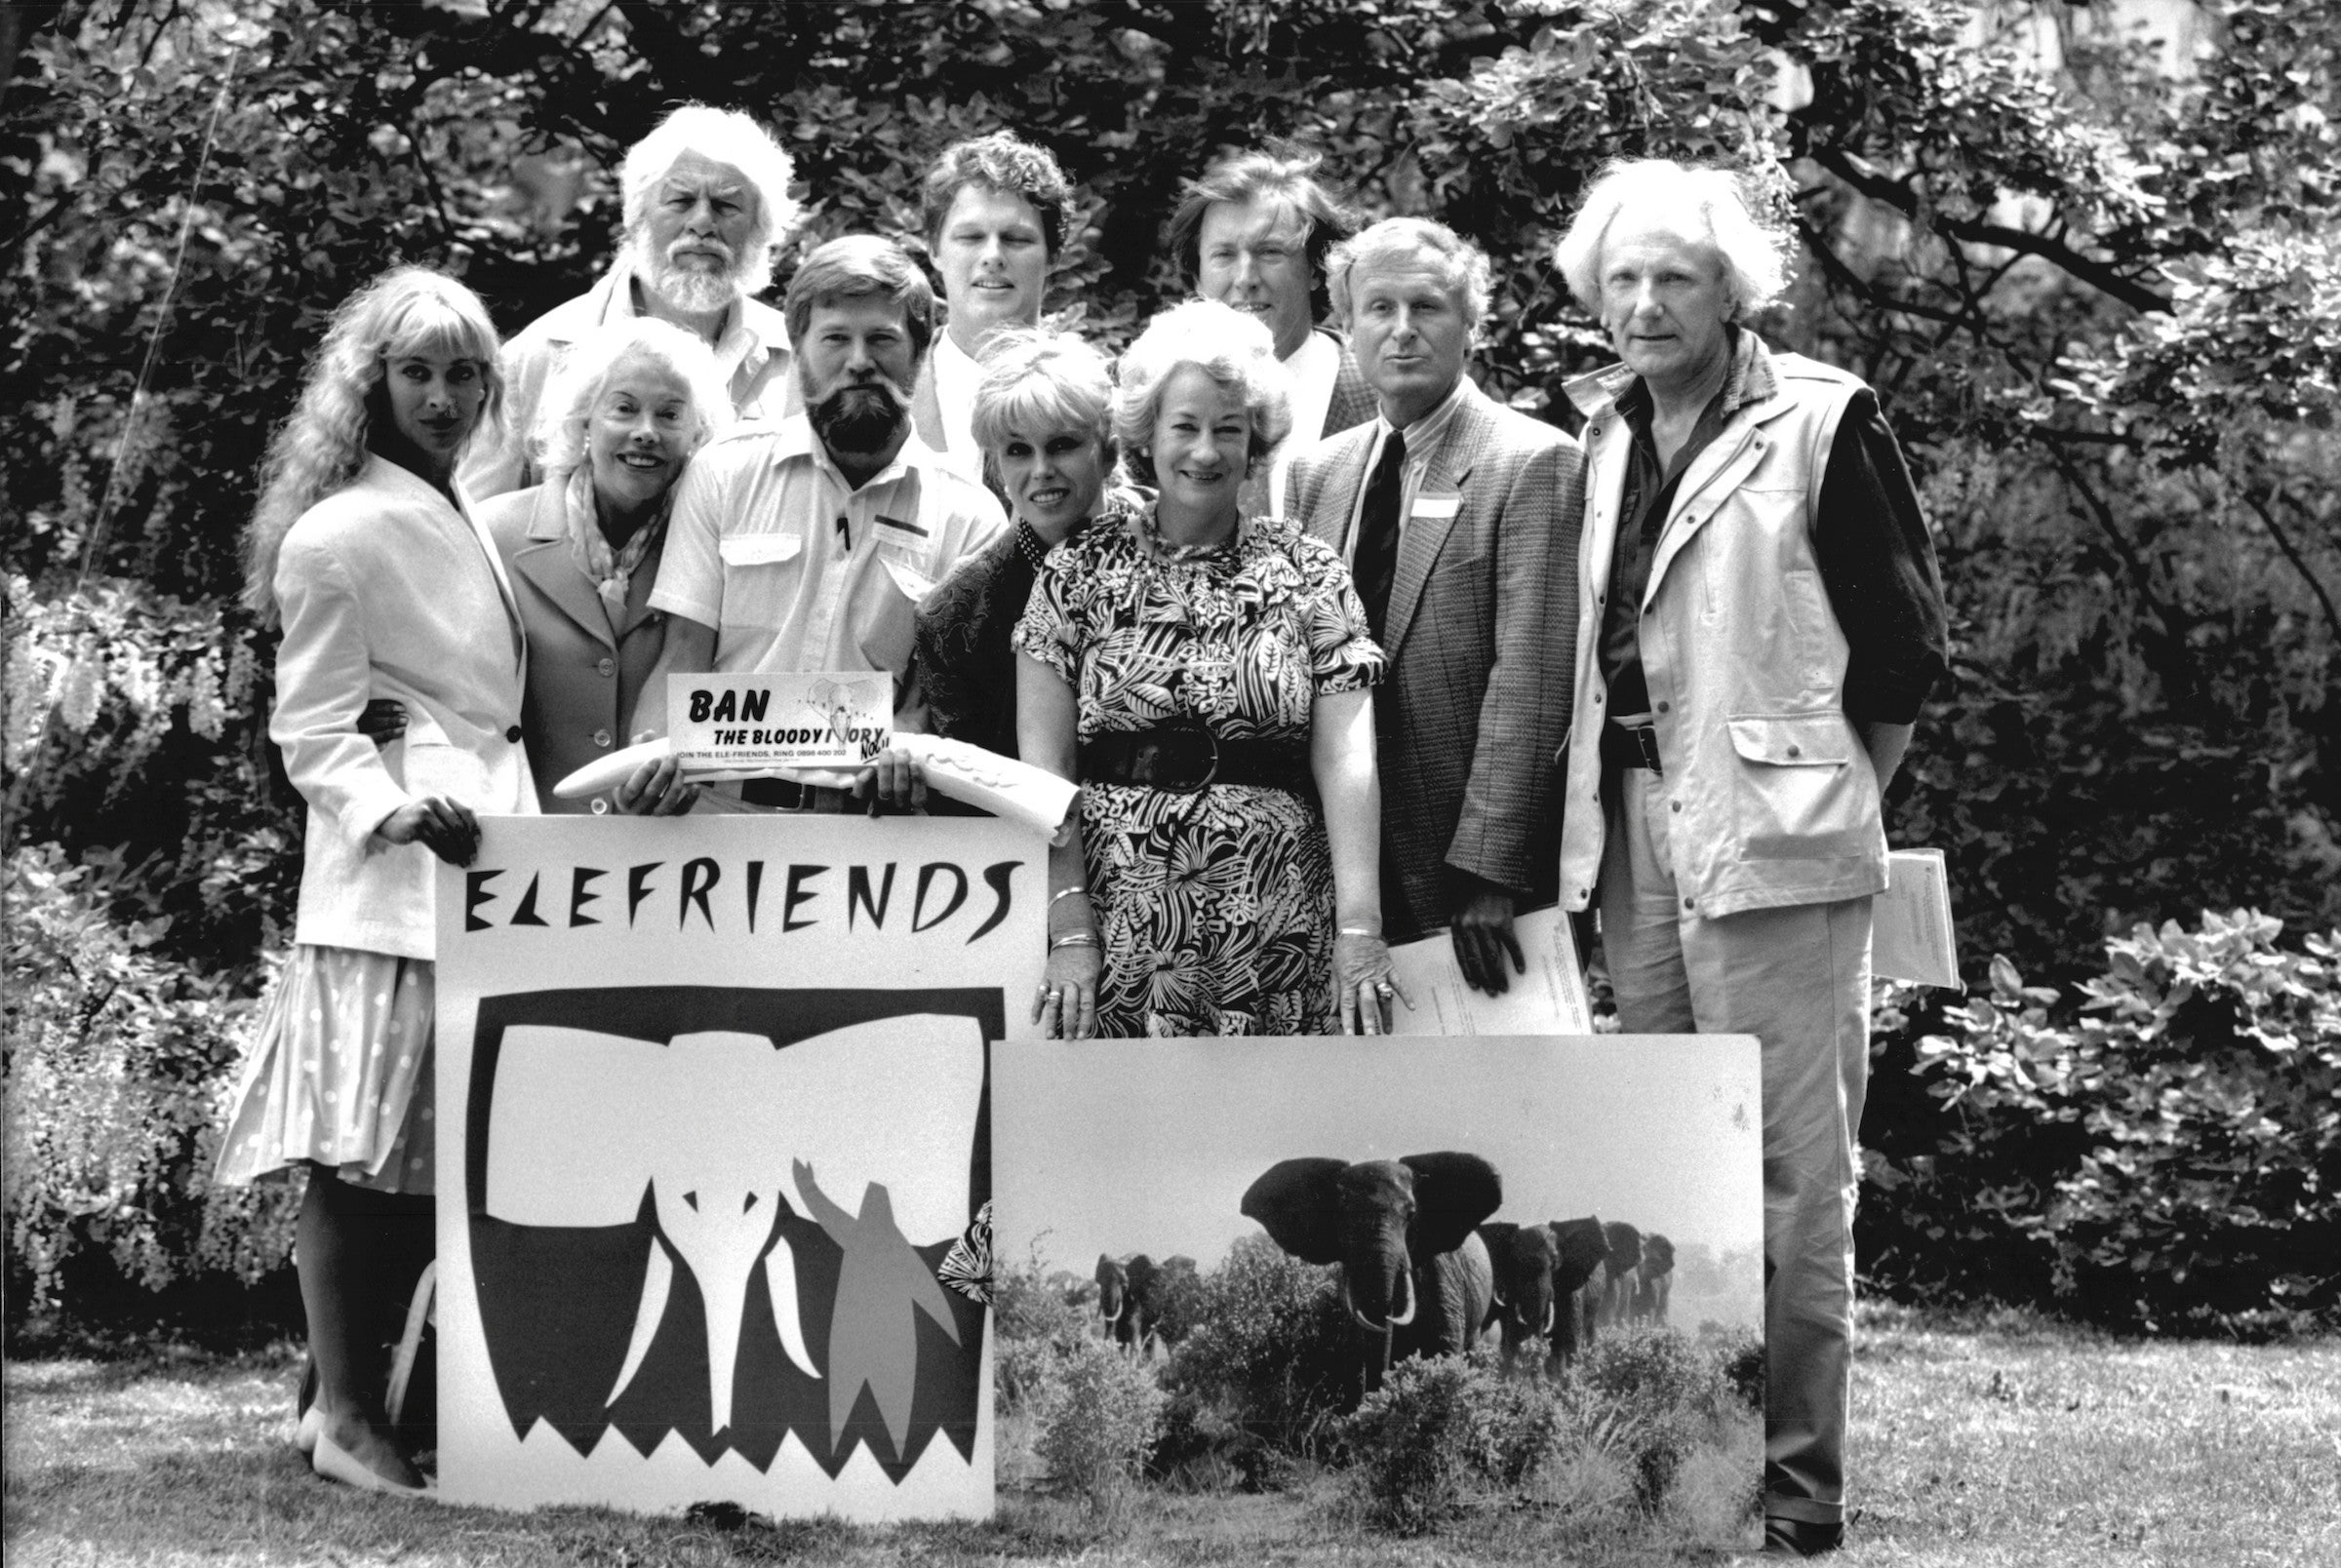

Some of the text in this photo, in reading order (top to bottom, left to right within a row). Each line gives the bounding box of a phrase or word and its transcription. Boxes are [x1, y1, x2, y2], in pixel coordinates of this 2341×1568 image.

[690, 689, 771, 723] BAN
[714, 729, 748, 745] THE
[752, 728, 822, 744] BLOODY
[465, 857, 1025, 946] ELEFRIENDS
